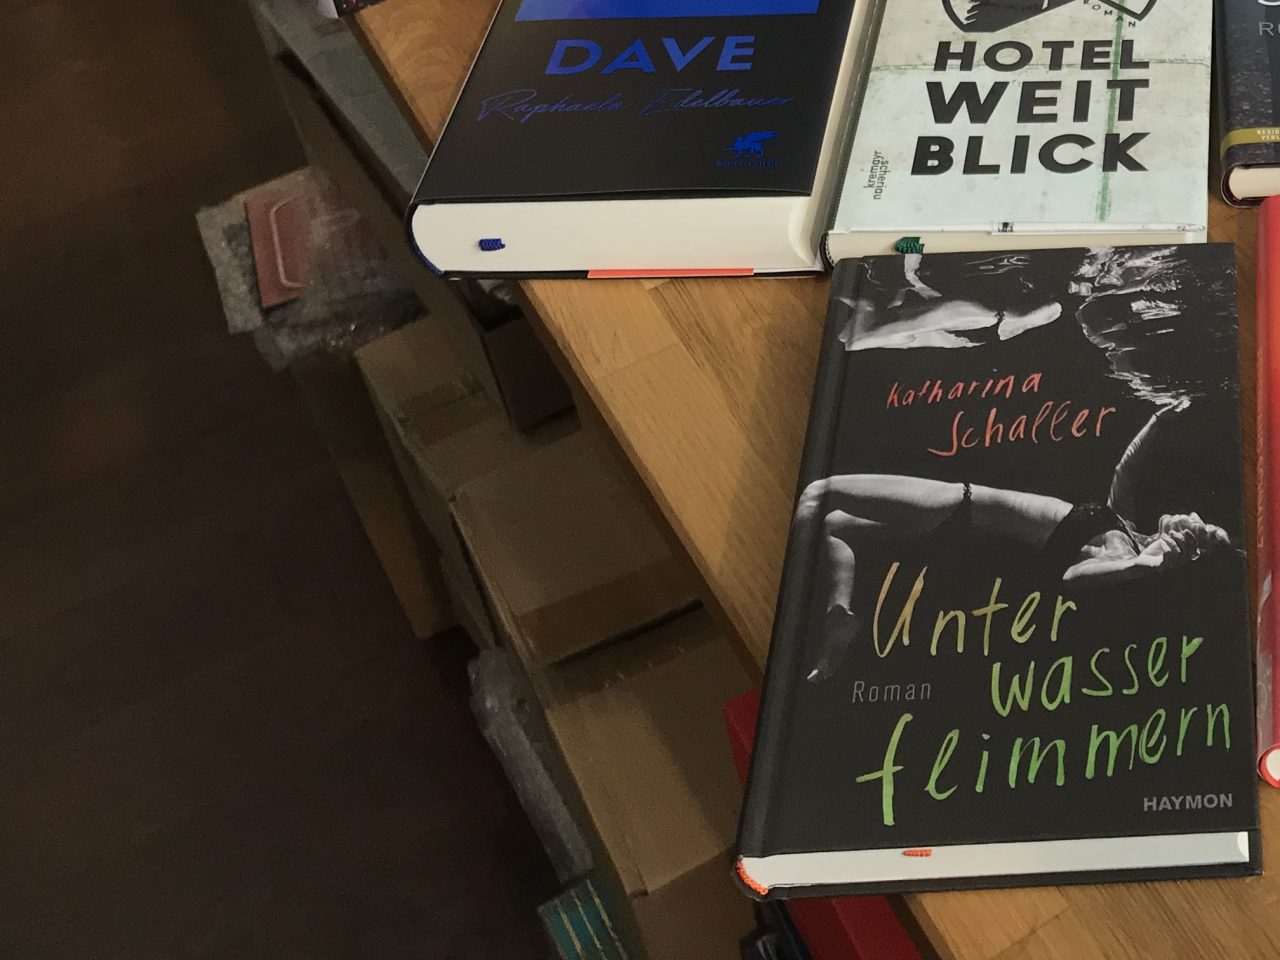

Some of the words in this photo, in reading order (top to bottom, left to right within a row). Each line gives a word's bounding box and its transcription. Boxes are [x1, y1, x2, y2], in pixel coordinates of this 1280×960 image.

[545, 35, 756, 75] DAVE
[933, 40, 1150, 72] HOTEL
[475, 88, 622, 124] Raphaela
[638, 88, 795, 116] Edelbauer
[926, 79, 1150, 124] WEIT
[863, 150, 884, 188] kremayr
[910, 132, 1151, 175] BLICK
[873, 160, 891, 199] scheriau
[885, 370, 1043, 410] Katharina
[927, 401, 1117, 457] Schaller
[873, 561, 1077, 659] Unter
[852, 678, 932, 704] Roman
[991, 635, 1204, 717] wasser
[855, 702, 1231, 827] flimmern
[1143, 793, 1234, 811] HAYMON
